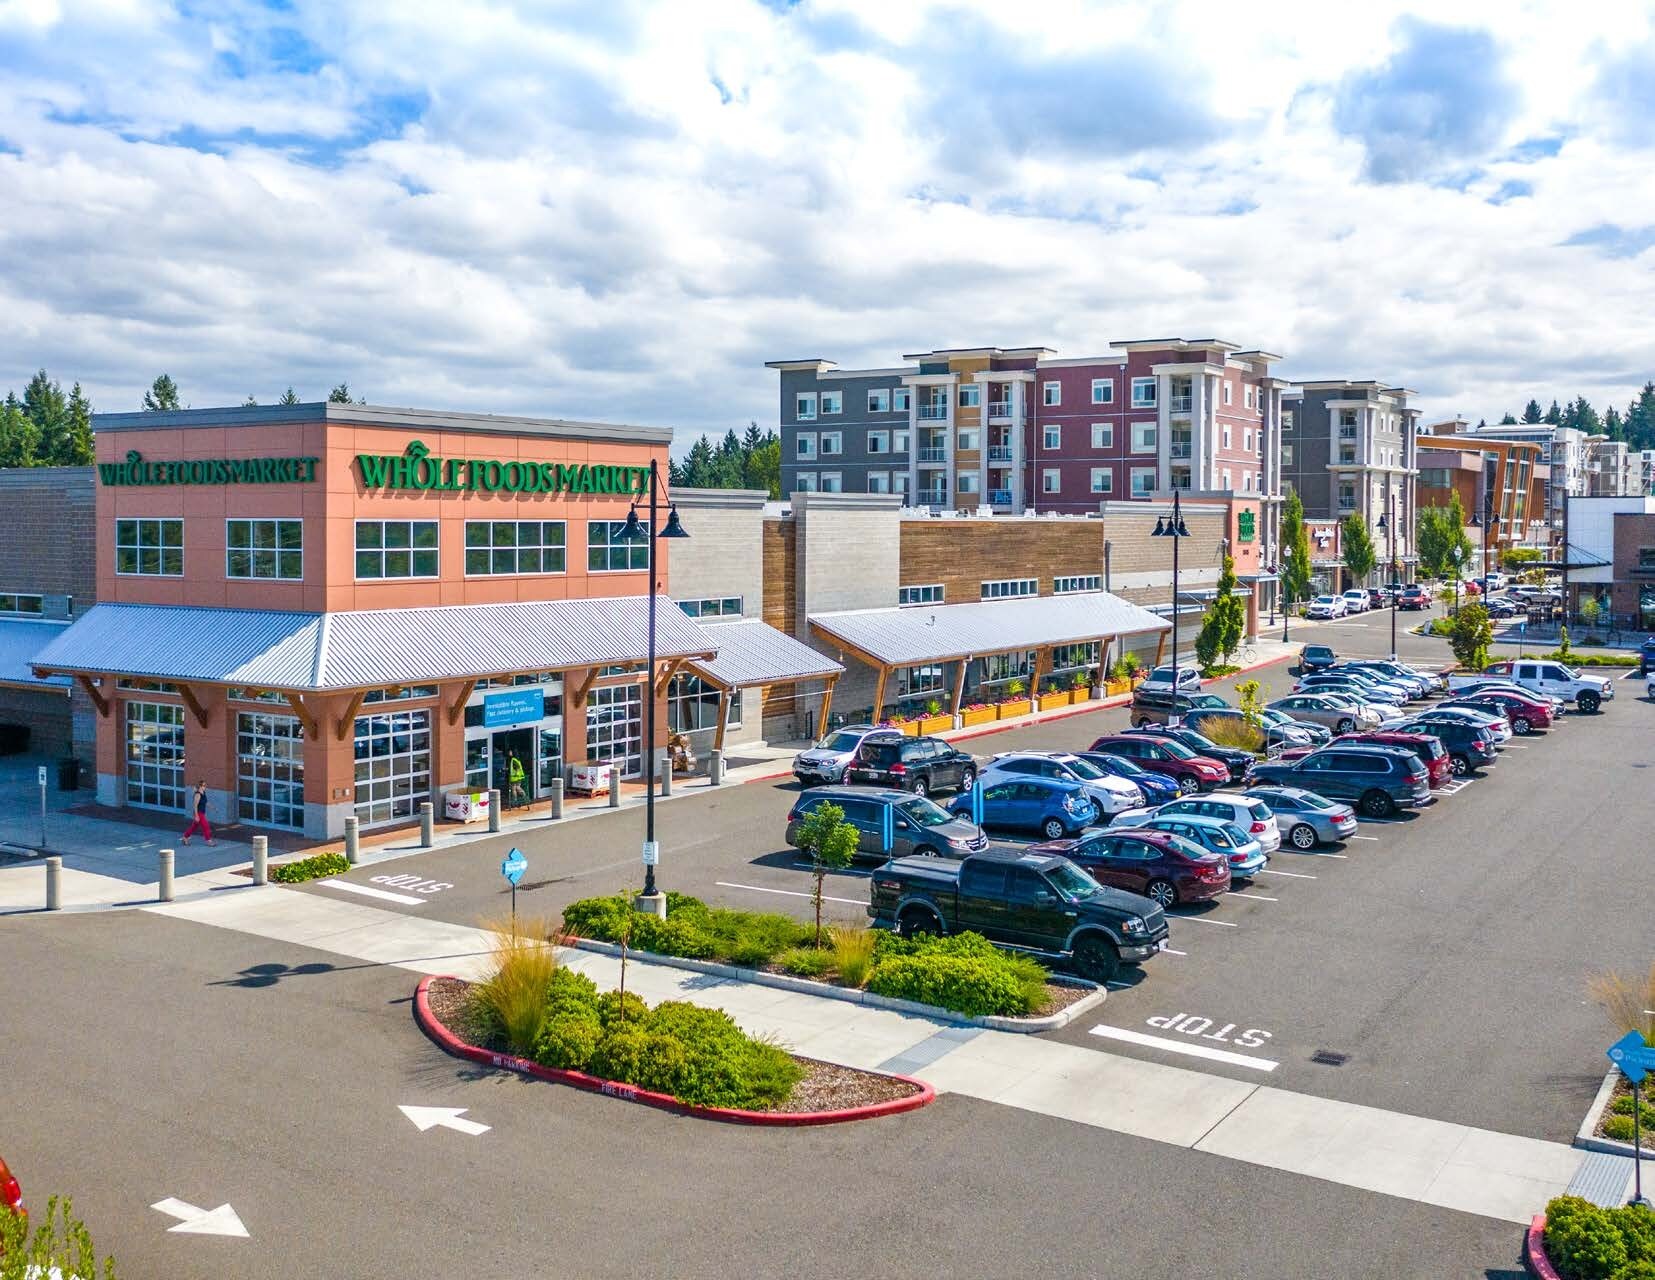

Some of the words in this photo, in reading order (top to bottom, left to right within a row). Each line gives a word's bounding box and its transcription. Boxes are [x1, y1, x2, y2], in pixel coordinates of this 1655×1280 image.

[98, 457, 167, 486] WHOLE
[165, 460, 230, 485] FOODS
[229, 457, 319, 484] MARKET
[357, 450, 466, 490] WHOLE
[468, 460, 555, 492] FOODS
[556, 464, 650, 494] MARKET
[369, 874, 454, 893] STOP
[1146, 1013, 1272, 1047] STOP
[493, 1056, 501, 1065] NO
[602, 1084, 616, 1096] FIRE
[619, 1087, 637, 1099] LANE
